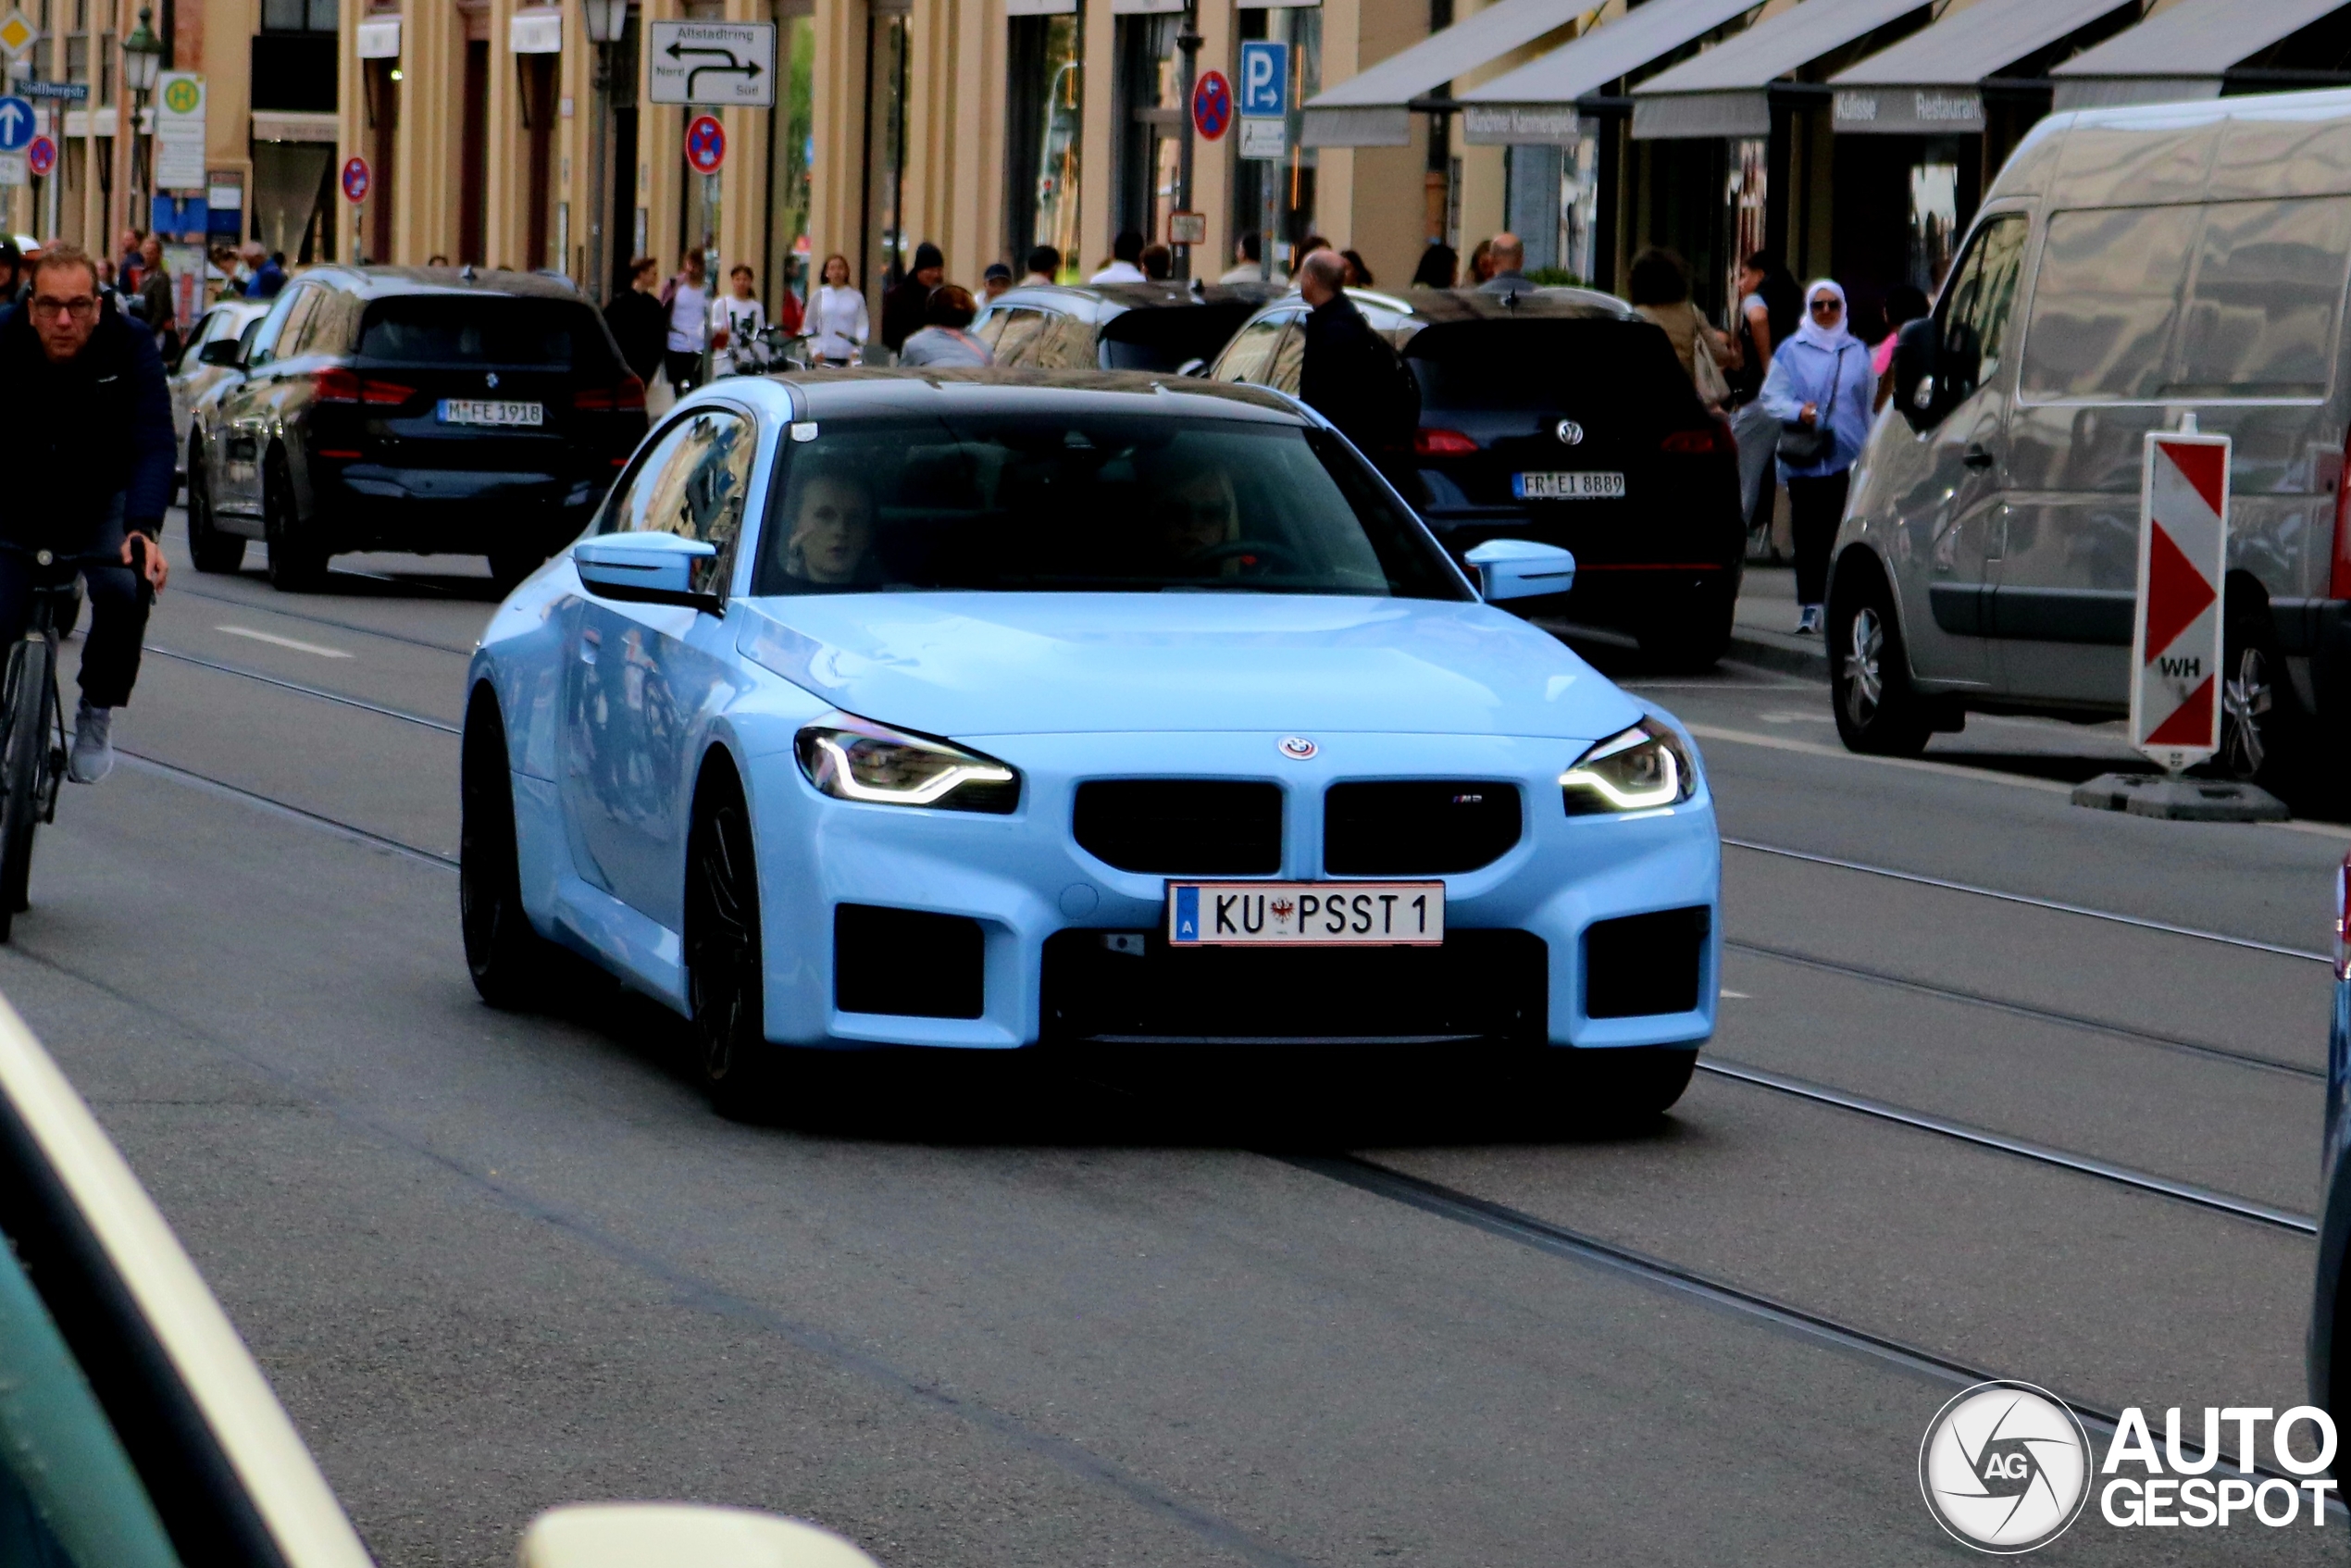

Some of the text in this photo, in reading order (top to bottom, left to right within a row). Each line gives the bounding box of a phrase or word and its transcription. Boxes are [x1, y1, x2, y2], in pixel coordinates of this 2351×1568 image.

[677, 27, 754, 44] Altstadtring
[656, 67, 685, 76] Nord
[1248, 51, 1274, 107] P
[1836, 91, 1982, 120] Kulisse Restaurant
[448, 402, 541, 422] M FE 1918
[1524, 476, 1545, 494] FR
[1584, 476, 1623, 494] 8889
[2160, 657, 2200, 678] WH
[1216, 894, 1426, 934] KU PSST 1
